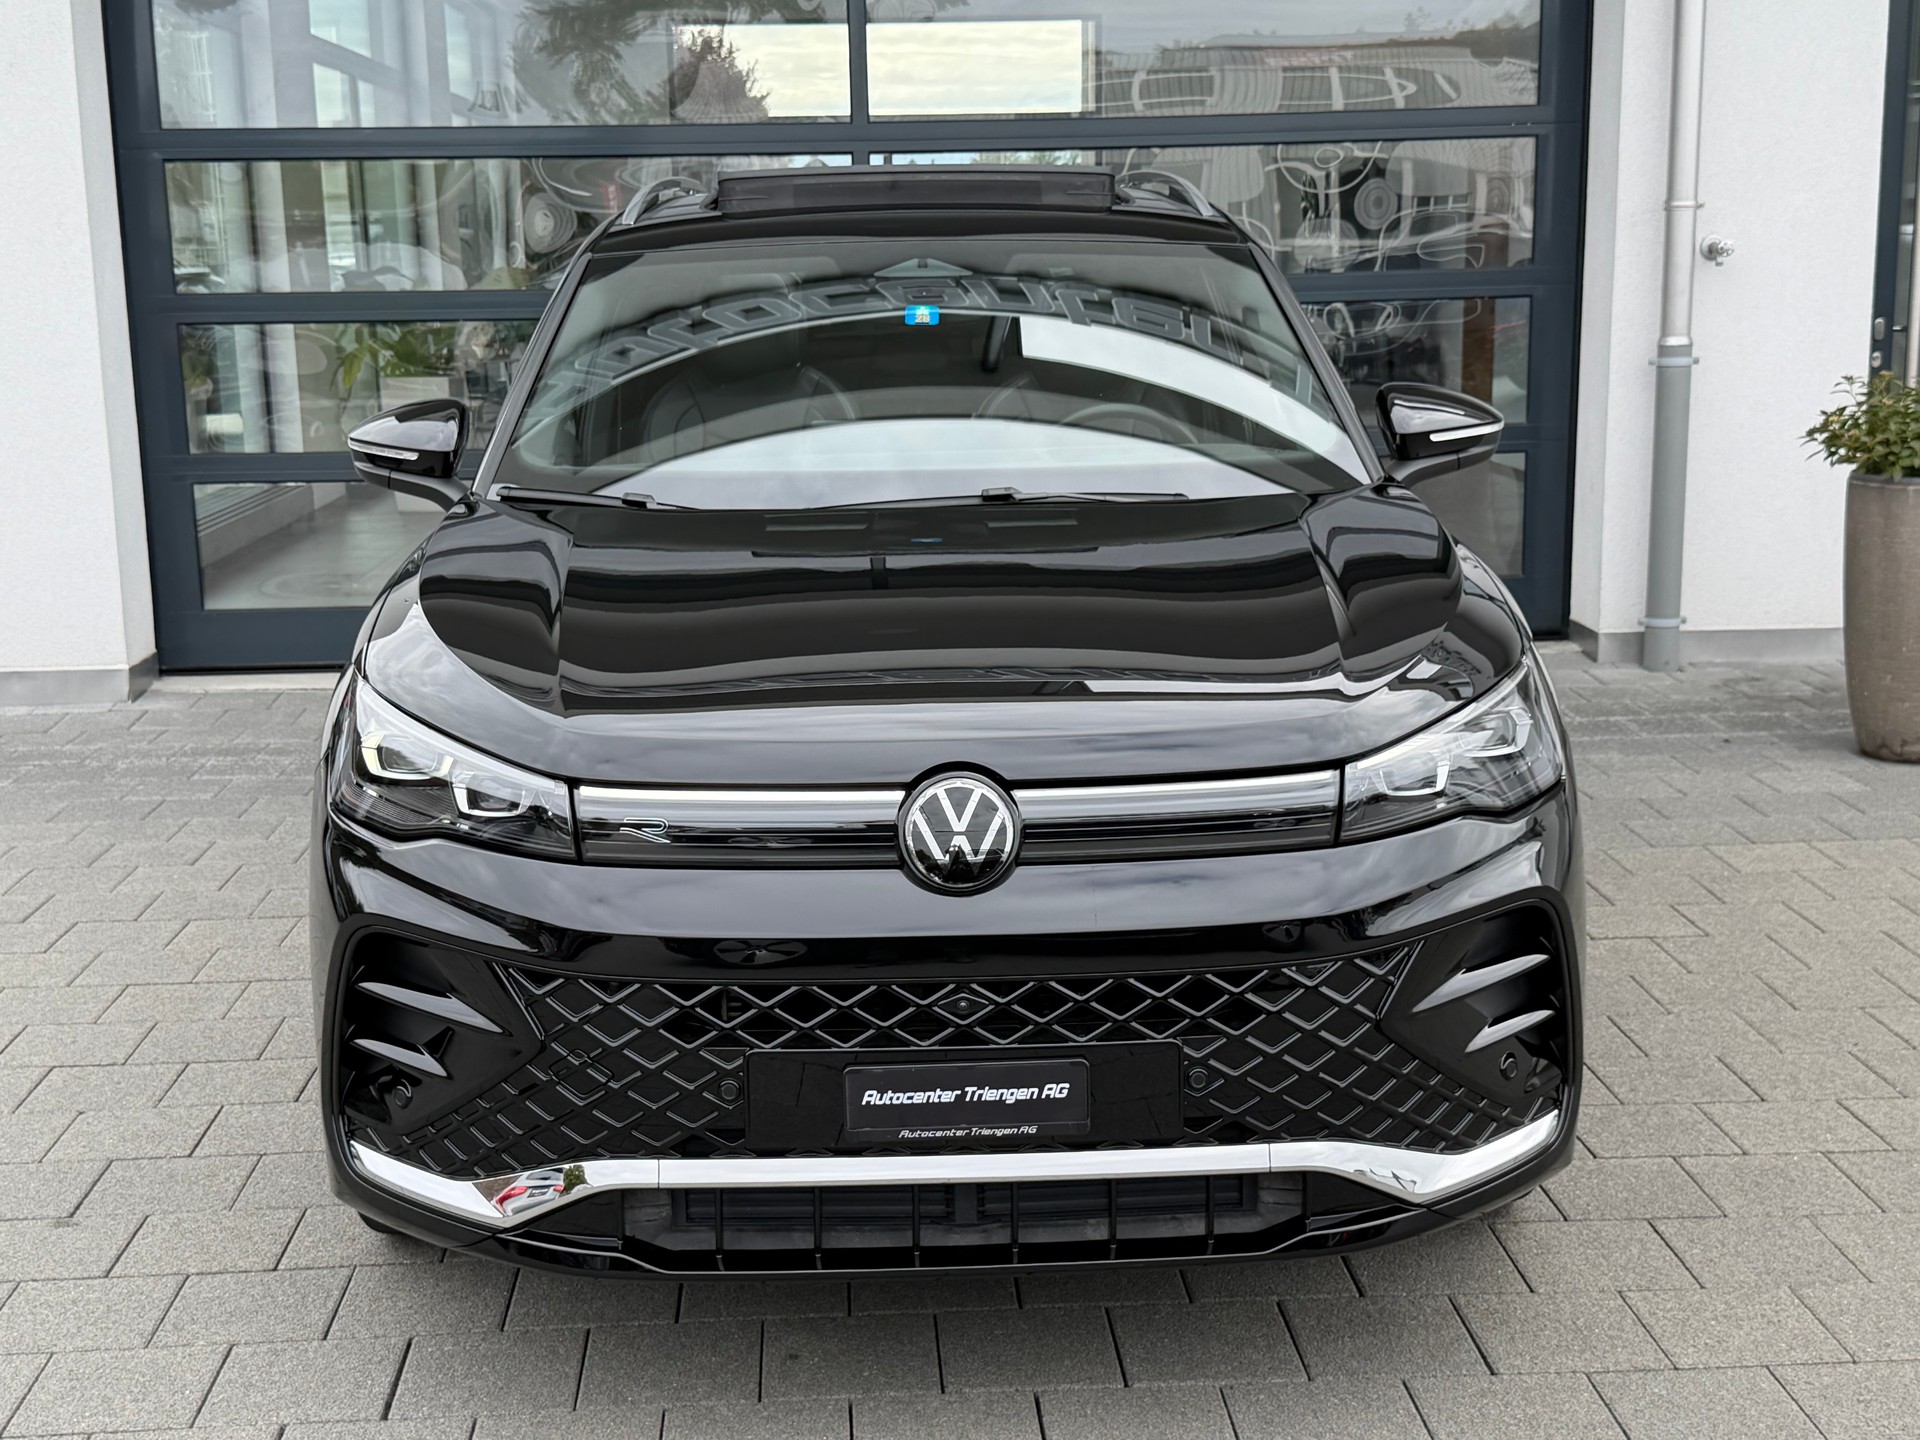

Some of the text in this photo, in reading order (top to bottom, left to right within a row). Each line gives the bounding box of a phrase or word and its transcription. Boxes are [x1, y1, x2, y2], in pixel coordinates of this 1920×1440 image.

[862, 1083, 1070, 1105] Autocenter Triengen AG
[898, 1128, 969, 1138] Autocenter
[1018, 1125, 1038, 1135] AG
